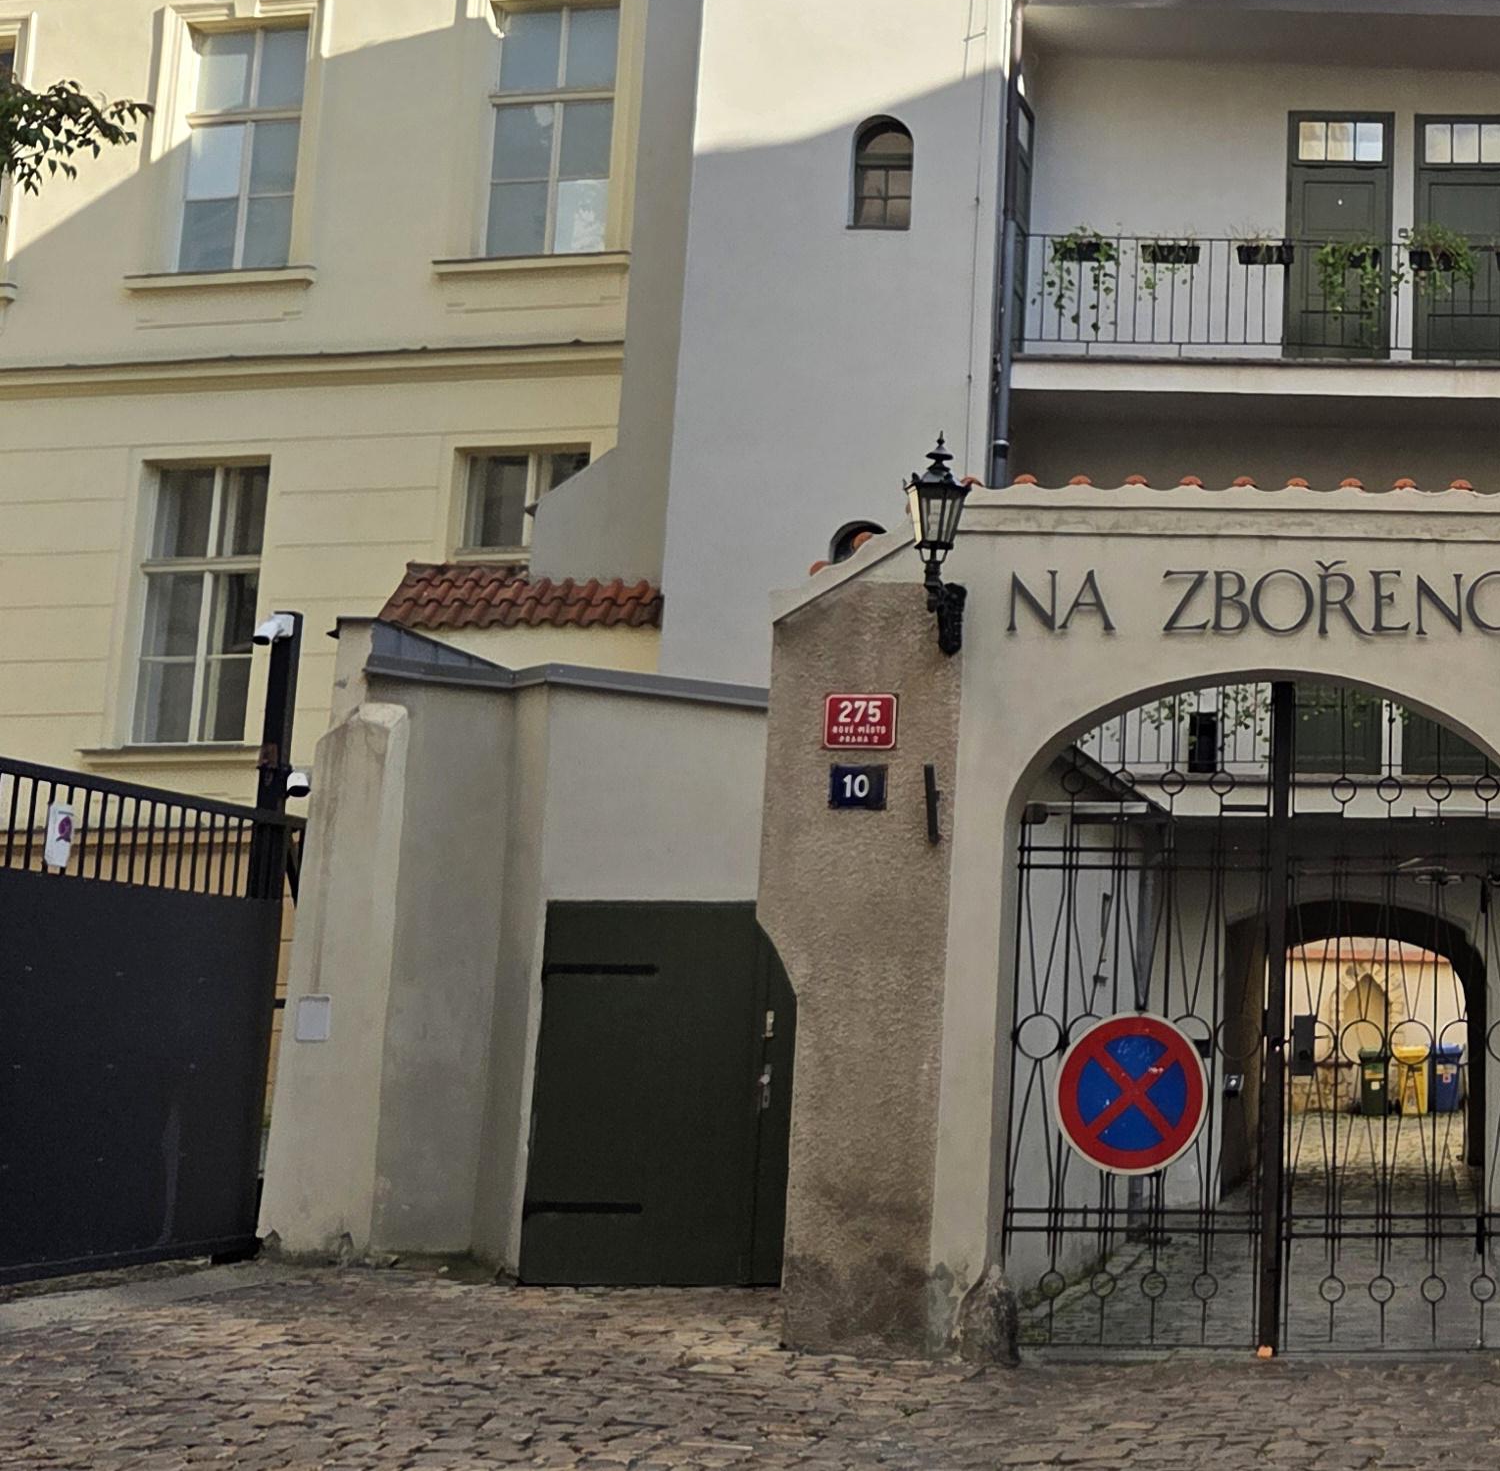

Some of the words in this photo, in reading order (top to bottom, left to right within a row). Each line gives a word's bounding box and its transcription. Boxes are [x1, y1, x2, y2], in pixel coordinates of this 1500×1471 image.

[1006, 568, 1116, 632] NA
[838, 700, 882, 723] 275
[843, 774, 870, 798] 10
